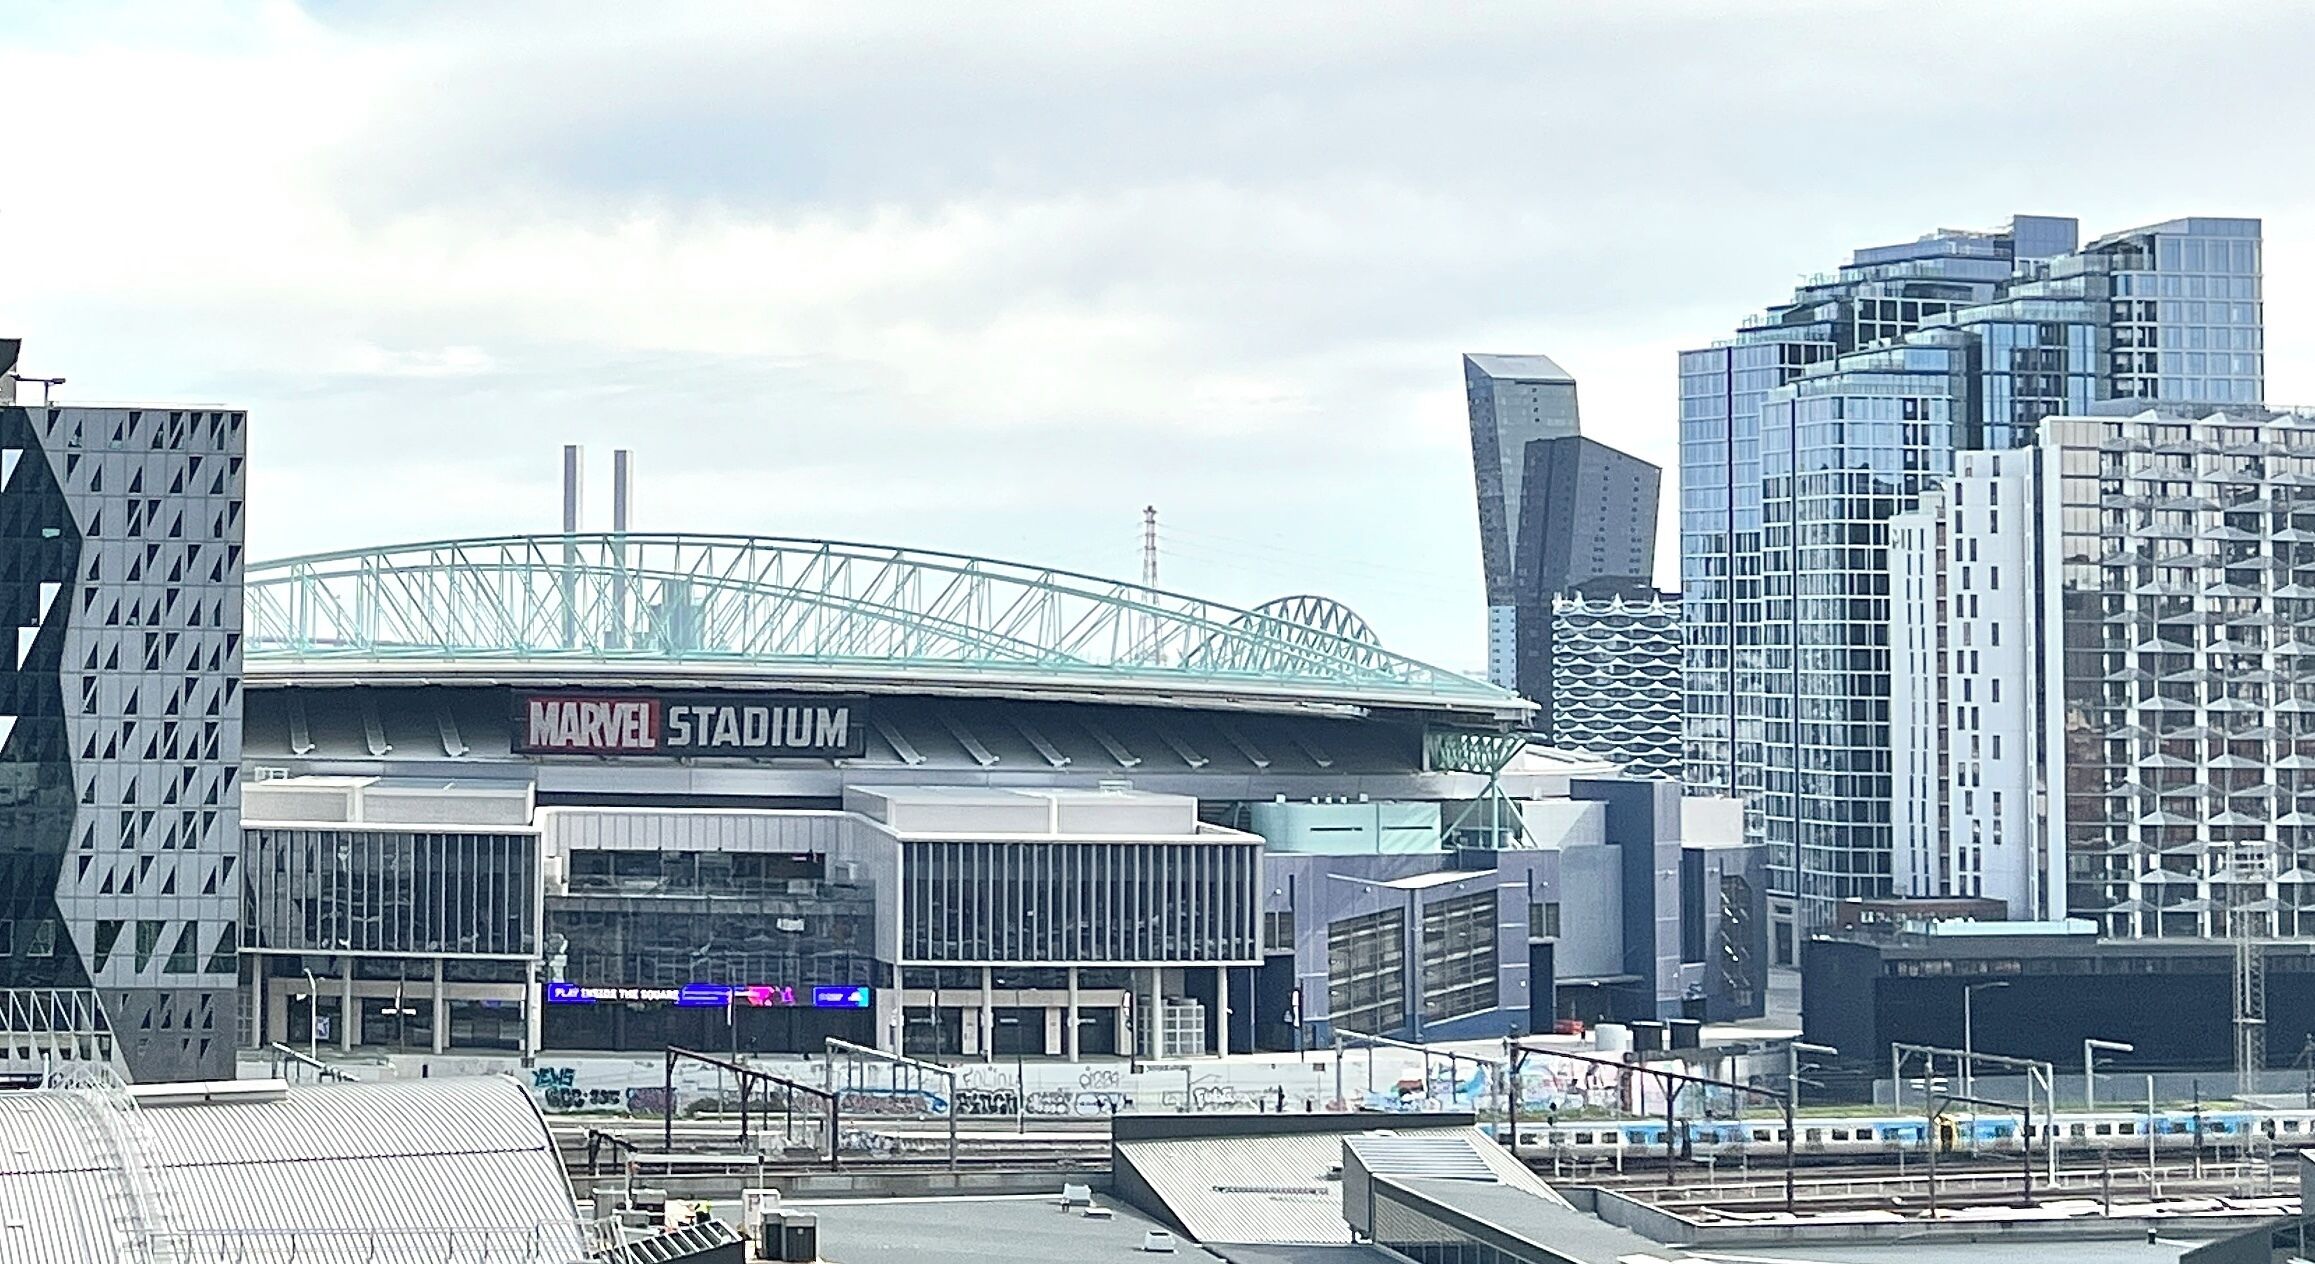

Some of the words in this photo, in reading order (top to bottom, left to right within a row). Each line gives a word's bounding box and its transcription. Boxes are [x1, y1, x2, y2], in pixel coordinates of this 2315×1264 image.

[529, 700, 656, 748] MARVEL
[667, 705, 849, 748] STADIUM
[554, 986, 579, 998] PLAY
[618, 988, 639, 1000] THE
[640, 988, 680, 1001] SQUARE
